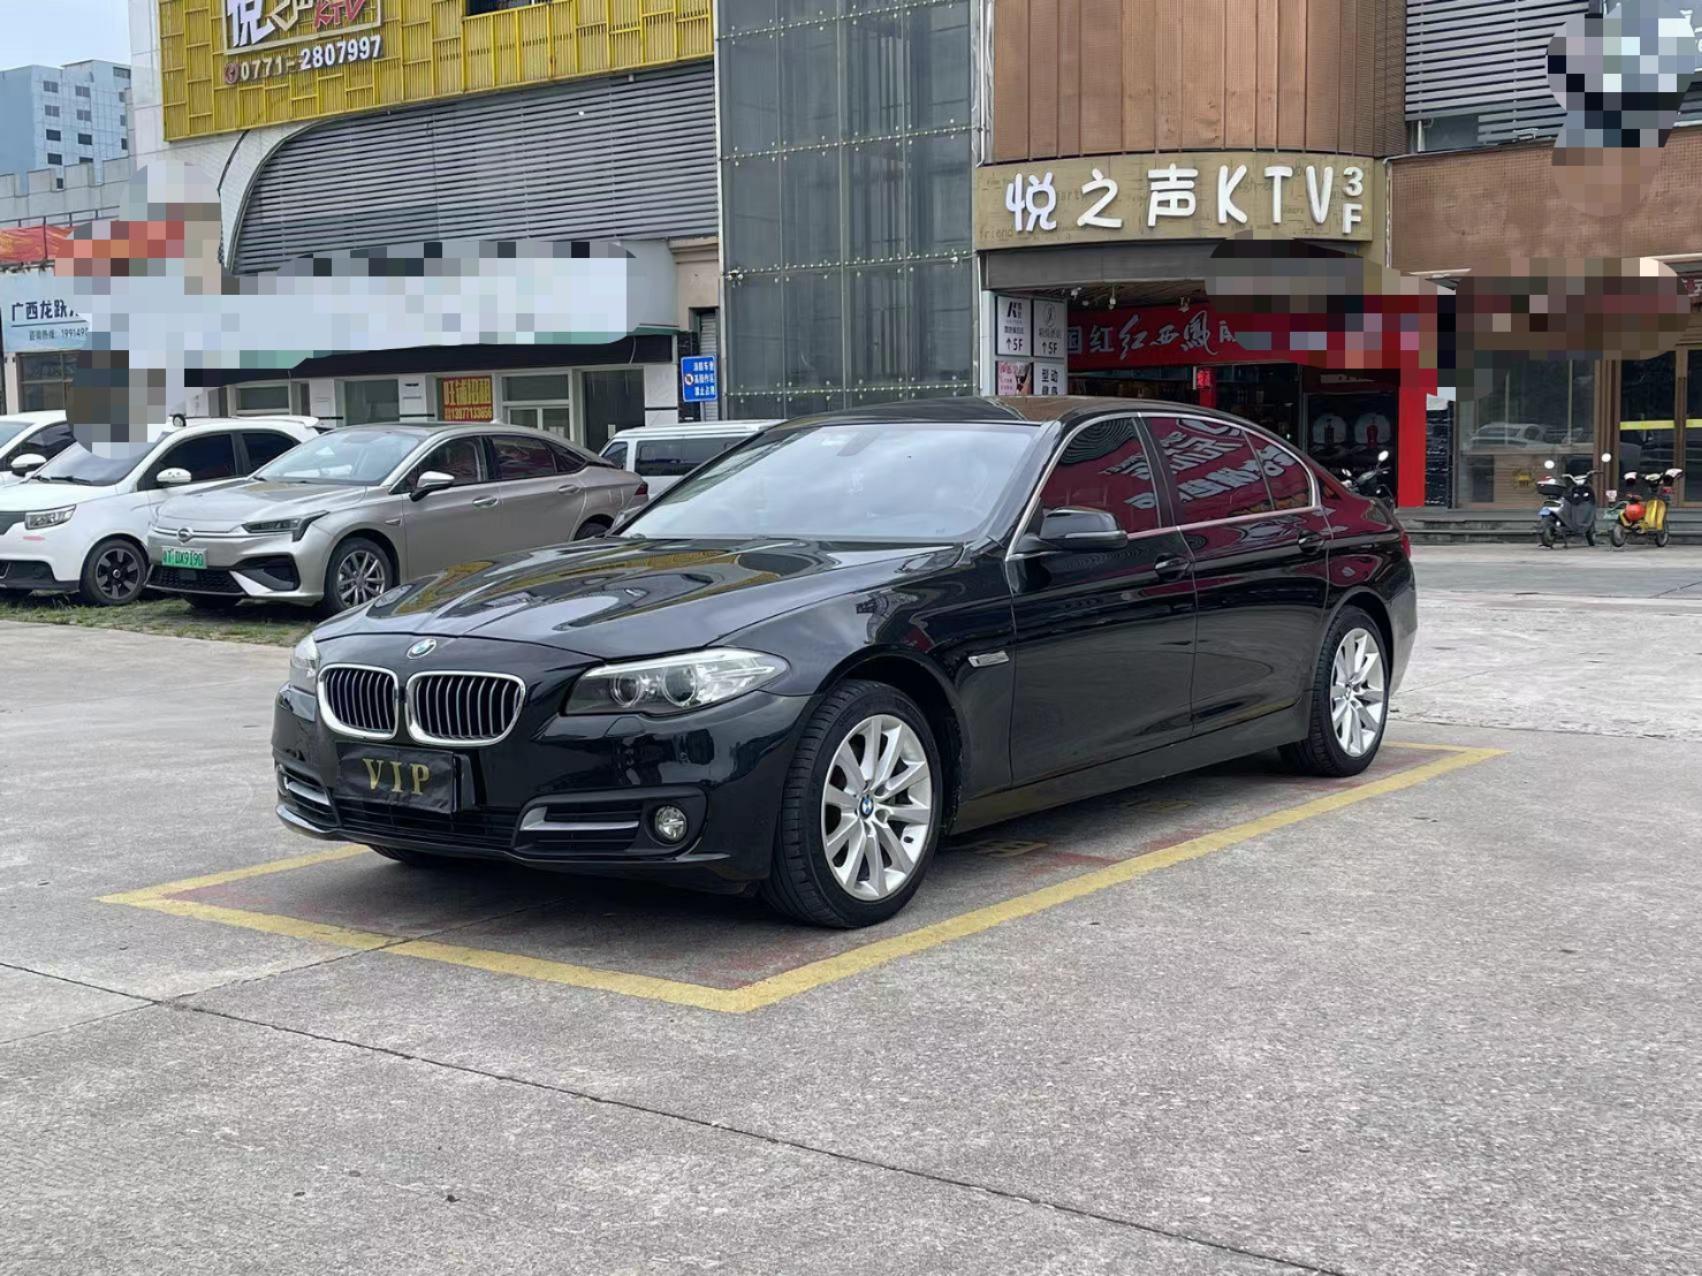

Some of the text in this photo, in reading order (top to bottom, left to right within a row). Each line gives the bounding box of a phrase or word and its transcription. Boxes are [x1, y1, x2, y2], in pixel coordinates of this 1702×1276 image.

[241, 35, 381, 81] 0771-2807997
[11, 299, 79, 321] 广西龙跃
[1013, 338, 1023, 351] 5F
[1048, 341, 1058, 355] 5F
[362, 758, 430, 795] VIP
